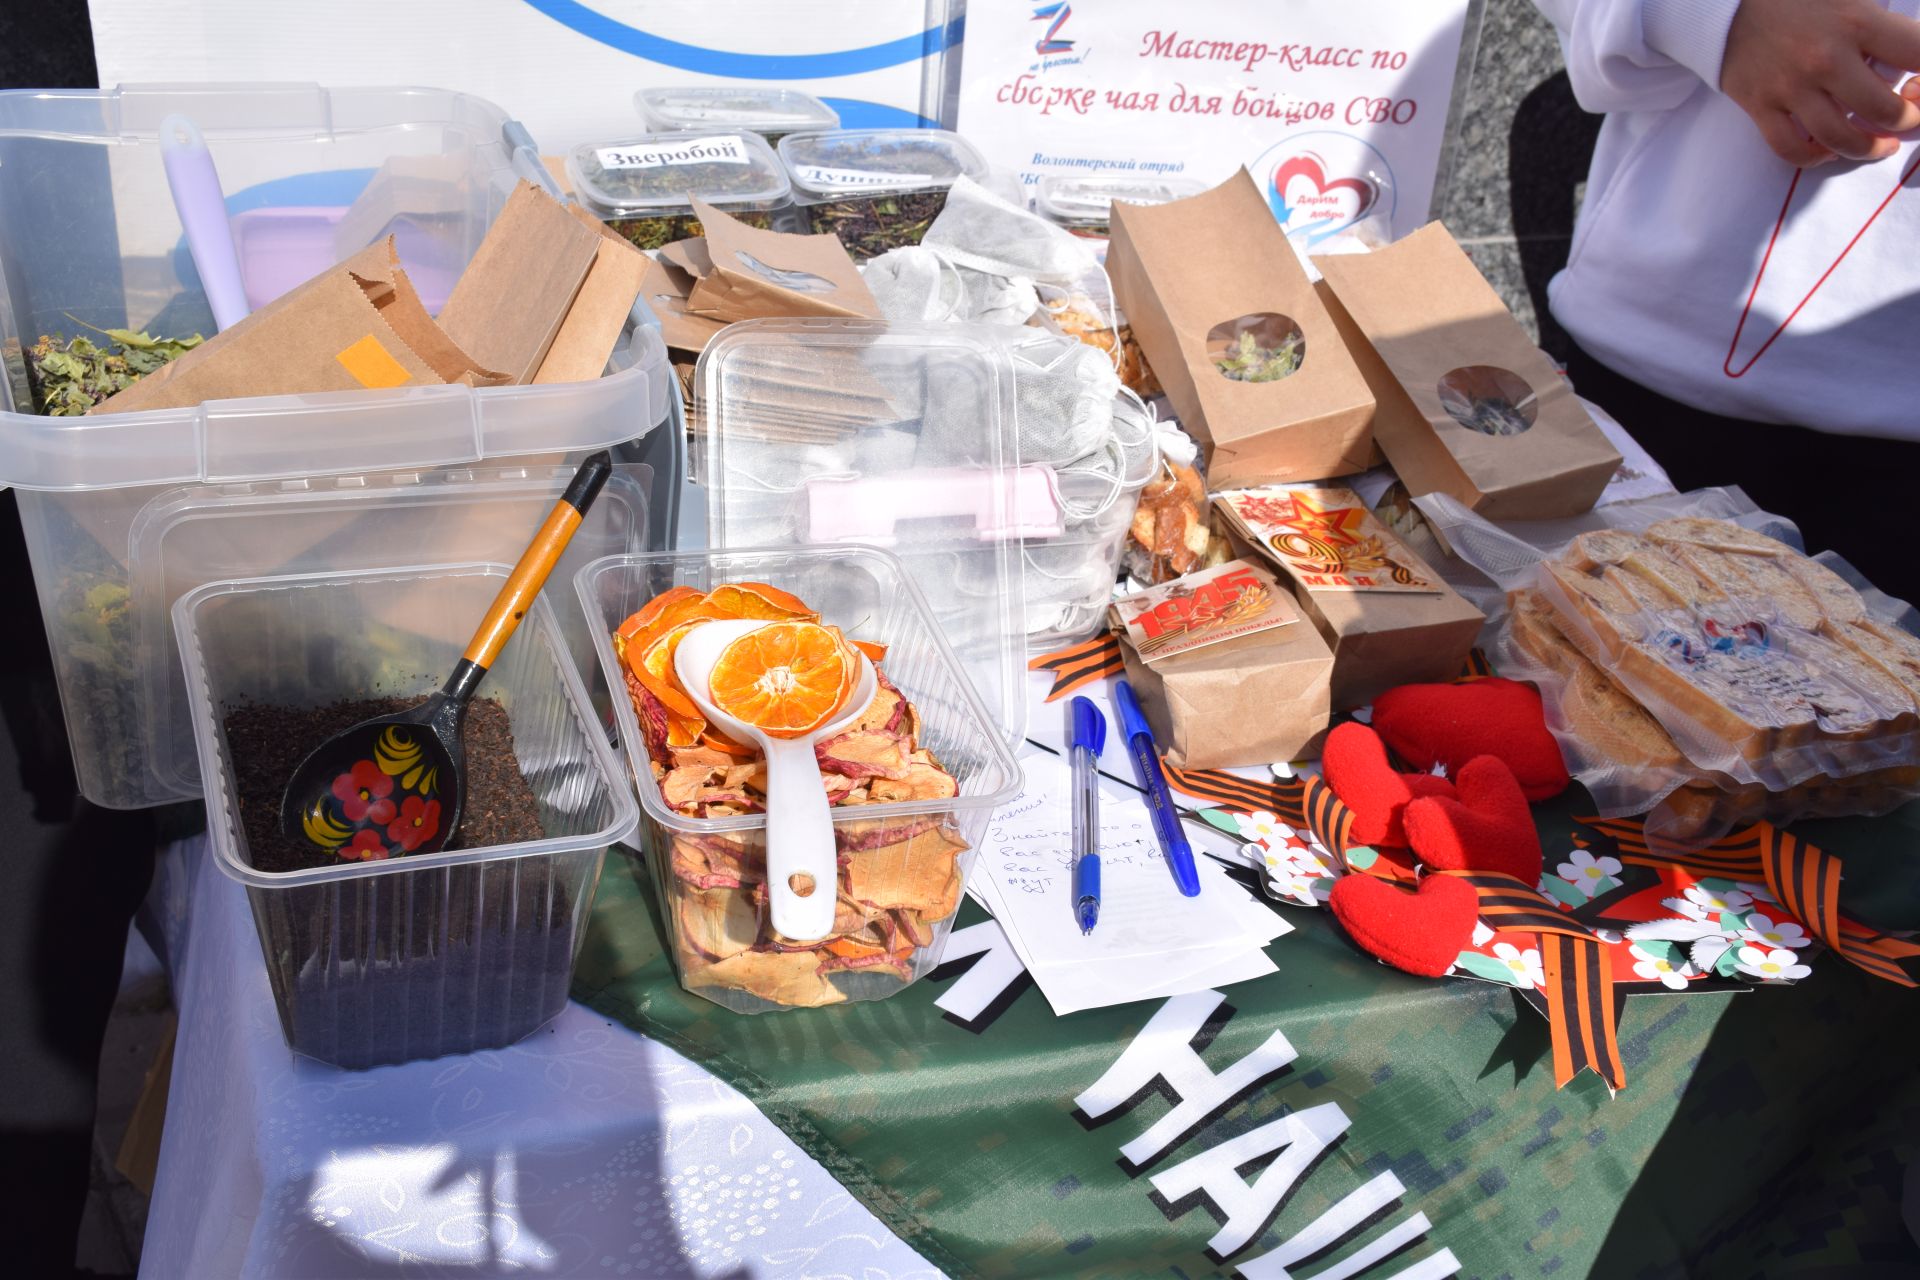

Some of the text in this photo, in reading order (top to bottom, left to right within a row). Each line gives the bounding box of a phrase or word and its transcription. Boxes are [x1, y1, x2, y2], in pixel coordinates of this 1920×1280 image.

[1139, 31, 1407, 72] Мастер-класс по
[997, 74, 1418, 126] сборке чая для бойцов СВО
[606, 142, 738, 167] Зверобой
[1032, 152, 1185, 175] Волонтерский отряд
[1296, 194, 1339, 206] Дарим
[1310, 210, 1345, 219] добро
[1301, 575, 1377, 586] МАЯ
[1129, 567, 1262, 640] 1945
